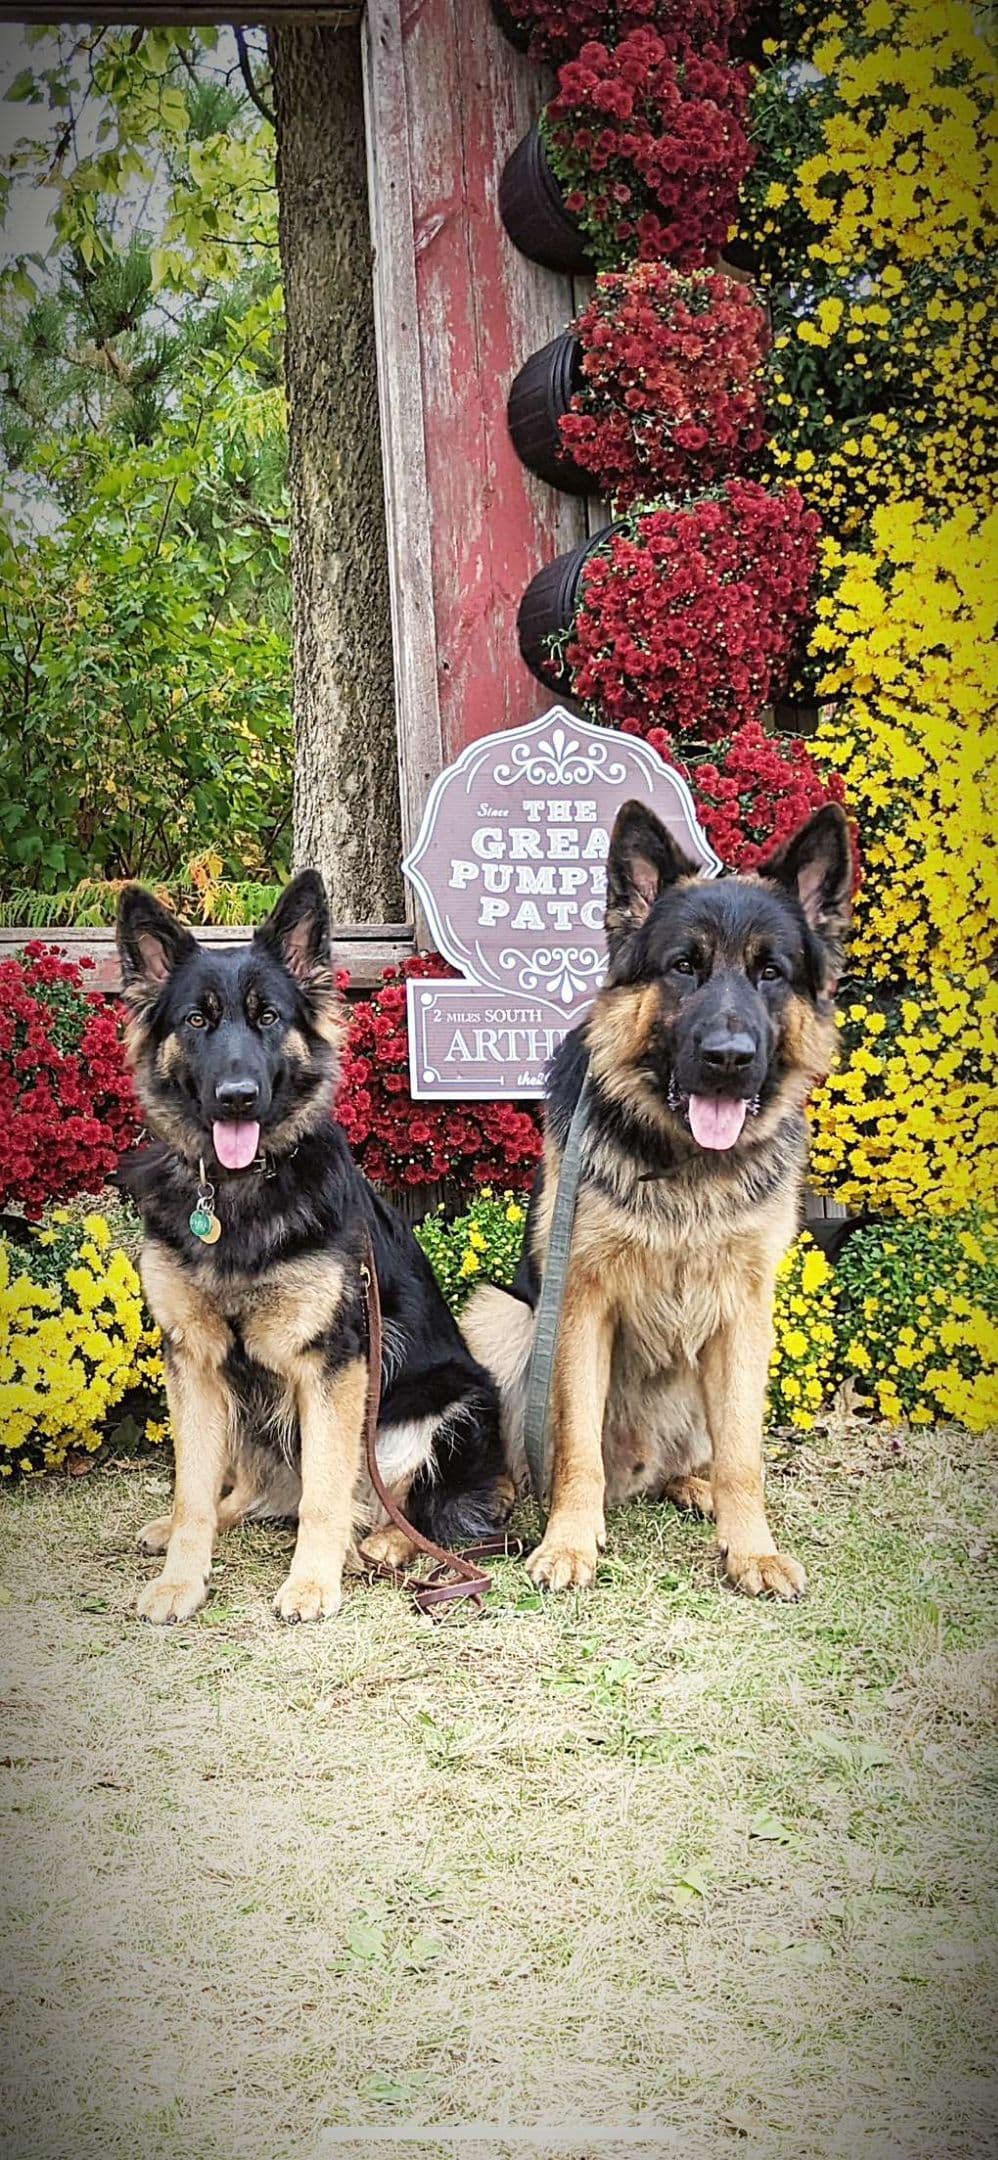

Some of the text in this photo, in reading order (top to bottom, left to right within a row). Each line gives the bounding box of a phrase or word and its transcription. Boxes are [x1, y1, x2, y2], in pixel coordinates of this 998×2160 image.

[477, 802, 510, 817] Since
[522, 800, 597, 822] THE
[471, 827, 609, 859] GREA
[478, 896, 607, 930] PATC
[433, 1009, 543, 1023] 2 MILES SOUTH
